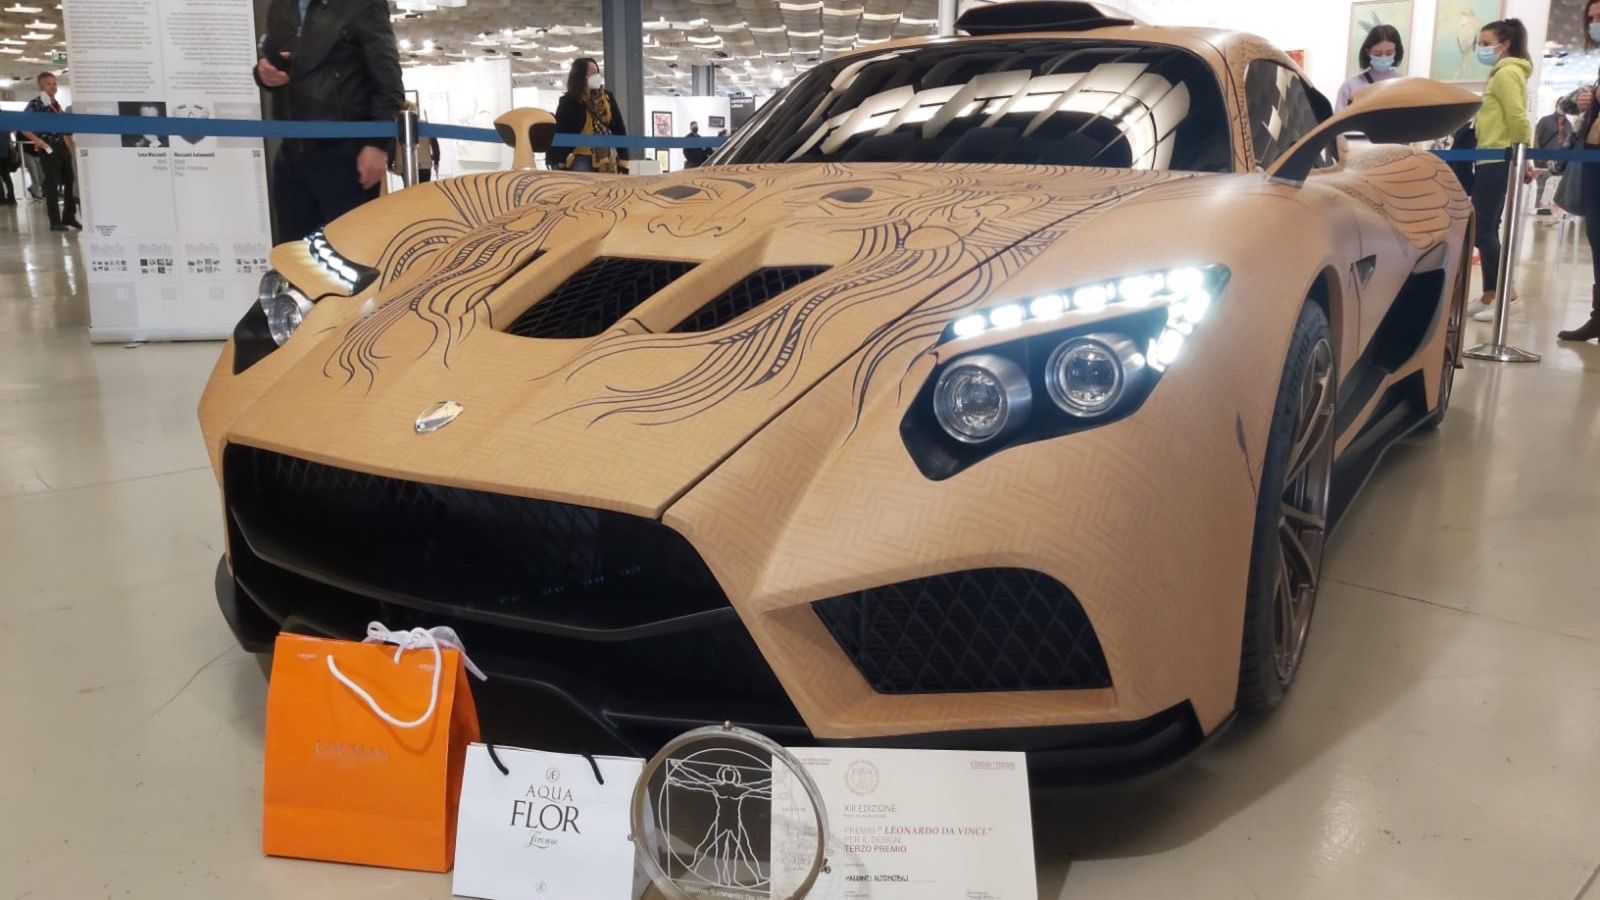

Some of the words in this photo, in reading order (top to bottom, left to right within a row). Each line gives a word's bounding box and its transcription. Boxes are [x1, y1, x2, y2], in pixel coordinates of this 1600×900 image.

[525, 784, 573, 803] AQUA
[858, 804, 896, 813] EDIZIONE
[510, 799, 581, 834] FLOR
[942, 826, 955, 835] DA
[844, 844, 872, 853] TERZO
[874, 845, 907, 853] PREMIO
